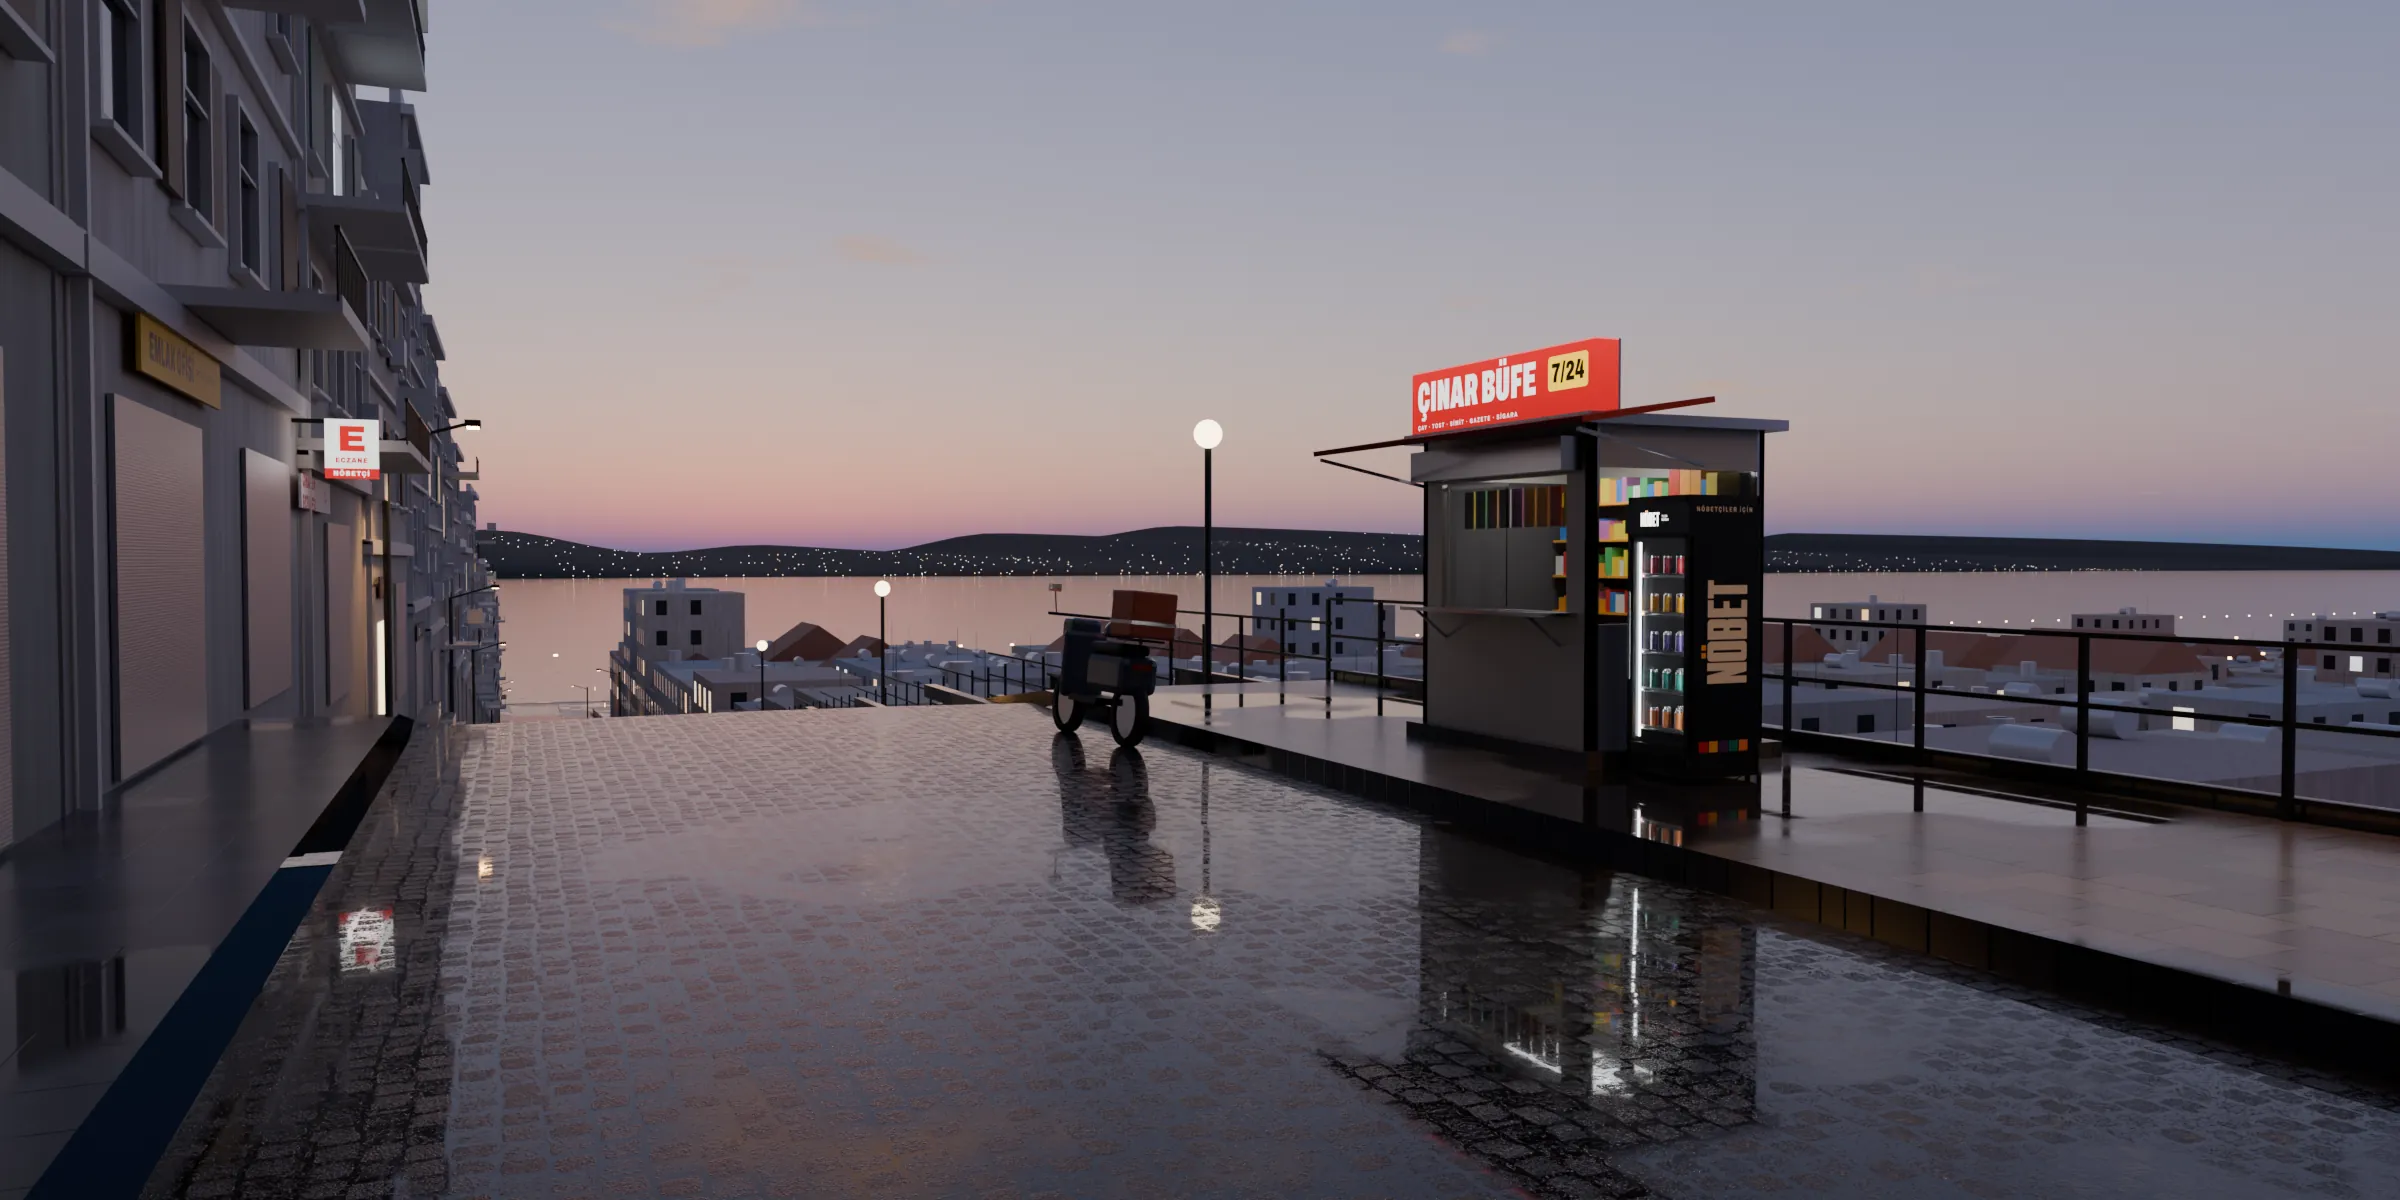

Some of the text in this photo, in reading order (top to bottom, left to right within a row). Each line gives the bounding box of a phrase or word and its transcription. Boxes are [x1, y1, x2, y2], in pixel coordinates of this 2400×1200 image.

[149, 331, 175, 373] EMLAK
[1551, 358, 1585, 384] 7/24
[1417, 358, 1537, 423] ÇINAR BÜFE
[339, 425, 365, 452] E
[1417, 424, 1428, 432] ÇAY
[1432, 421, 1445, 430] TOST
[1496, 411, 1519, 421] SİGARA
[1700, 579, 1749, 685] NÖBET
